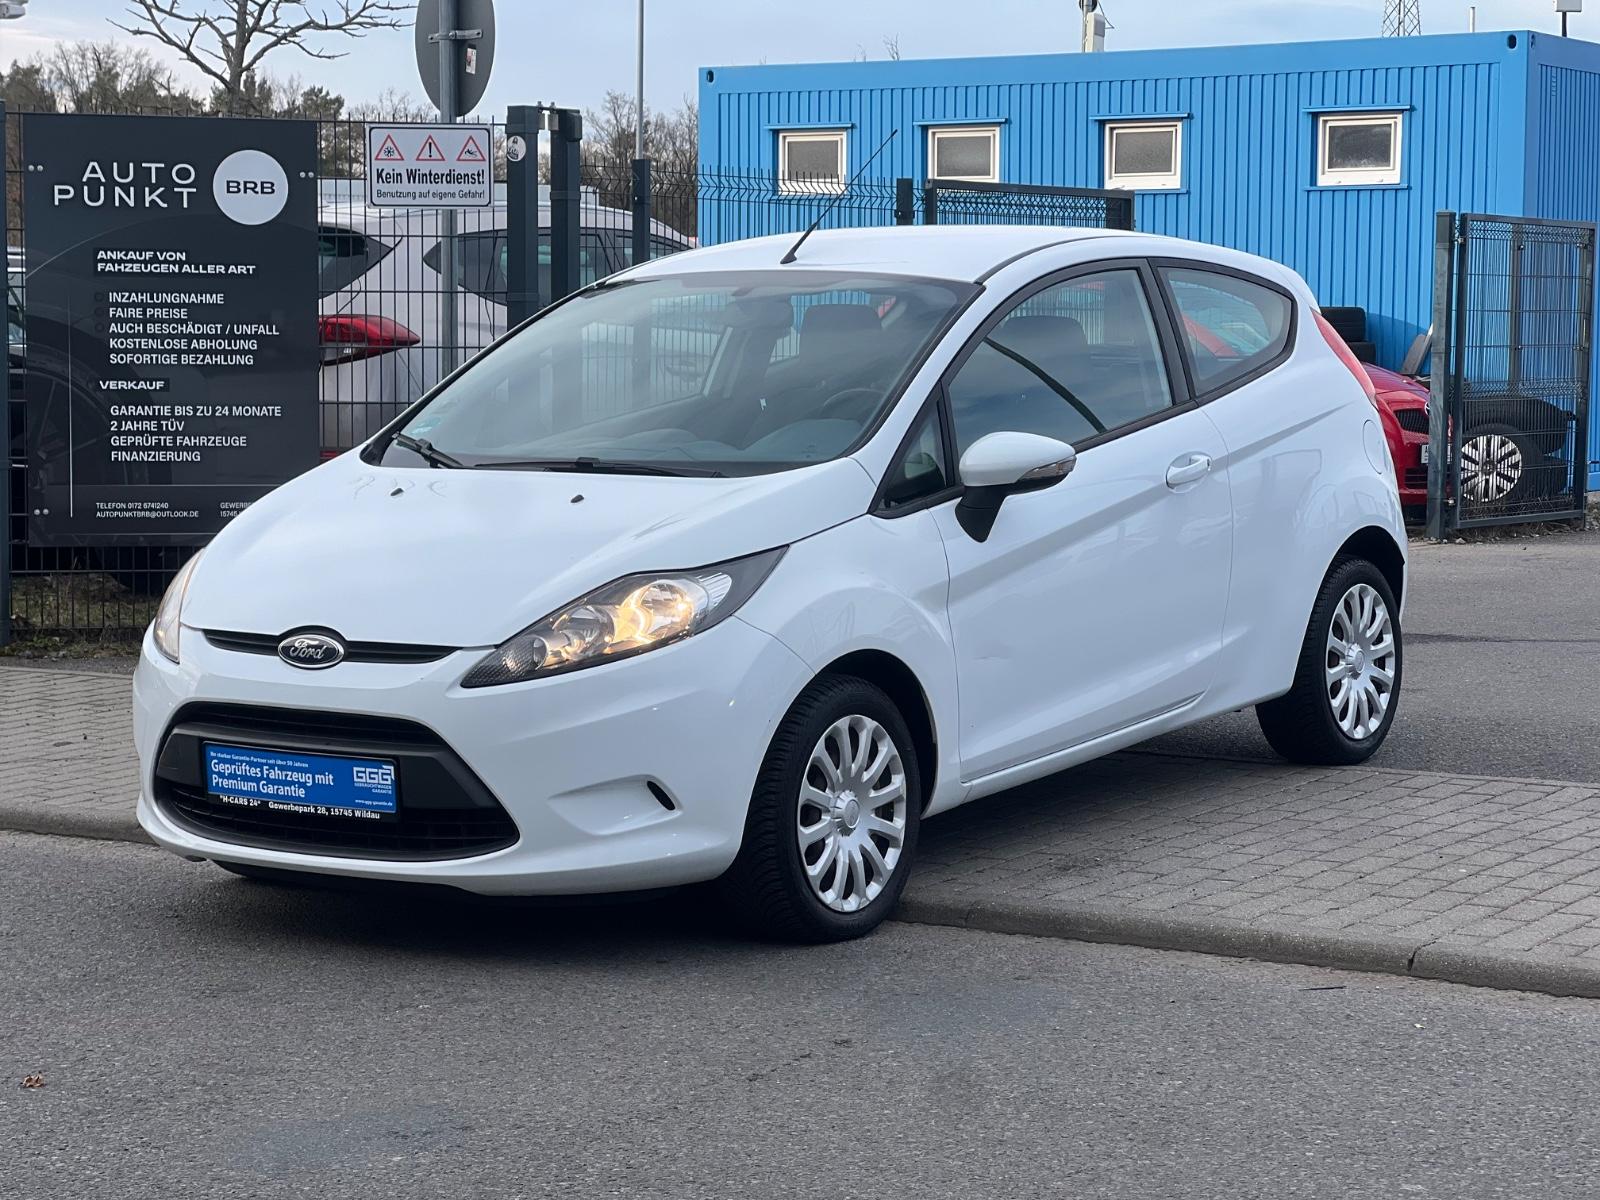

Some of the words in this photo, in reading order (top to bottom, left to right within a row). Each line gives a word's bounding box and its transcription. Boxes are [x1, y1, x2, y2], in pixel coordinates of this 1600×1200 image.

[82, 161, 196, 184] AUTO
[376, 168, 403, 185] Kein
[406, 168, 485, 185] Winterdienst!
[225, 179, 276, 195] BRB
[53, 184, 197, 208] PUNKT
[376, 189, 417, 200] Benutzung
[418, 189, 430, 199] auf
[431, 189, 456, 201] eigene
[458, 189, 485, 199] Gefahr!
[97, 250, 154, 260] ANKAUF
[156, 251, 186, 261] VON
[97, 262, 179, 273] FAHZEUGEN
[181, 264, 226, 274] ALLER
[227, 265, 256, 275] ART
[109, 292, 224, 304] INZAHLUNGNAHME
[109, 307, 143, 318] FAIRE
[146, 308, 188, 319] PREISE
[109, 323, 143, 334] AUCH
[147, 321, 223, 335] BESCHÄDIGT
[225, 324, 230, 335] /
[234, 324, 280, 335] UNFALL
[109, 338, 188, 350] KOSTENLOSE
[190, 339, 258, 350] ABHOLUNG
[109, 353, 178, 365] SOFORTIGE
[181, 354, 254, 365] BEZAHLUNG
[99, 380, 165, 390] VERKAUF
[110, 405, 172, 416] GARANTIE
[174, 406, 193, 416] BIS
[196, 406, 212, 416] ZU
[215, 406, 229, 416] 24
[232, 406, 282, 416] MONATE
[110, 421, 118, 431] 2
[120, 421, 158, 432] JAHRE
[160, 418, 185, 431] TÜV
[110, 433, 173, 447] GEPRÜFTE
[176, 436, 247, 447] FAHRZEUGE
[111, 451, 201, 462] FINANZIERUNG
[96, 502, 126, 510] TELEFON
[289, 638, 327, 660] Ford
[211, 759, 261, 777] Geprüftes
[263, 765, 313, 786] Fahrzeug
[315, 771, 334, 786] mit
[353, 766, 392, 784] GGG
[212, 774, 257, 792] Premium
[259, 780, 306, 798] Garantie
[268, 801, 315, 814] Gewerbepark
[317, 806, 329, 816] 28,
[330, 808, 353, 817] 15745
[354, 809, 380, 819] Wildau
